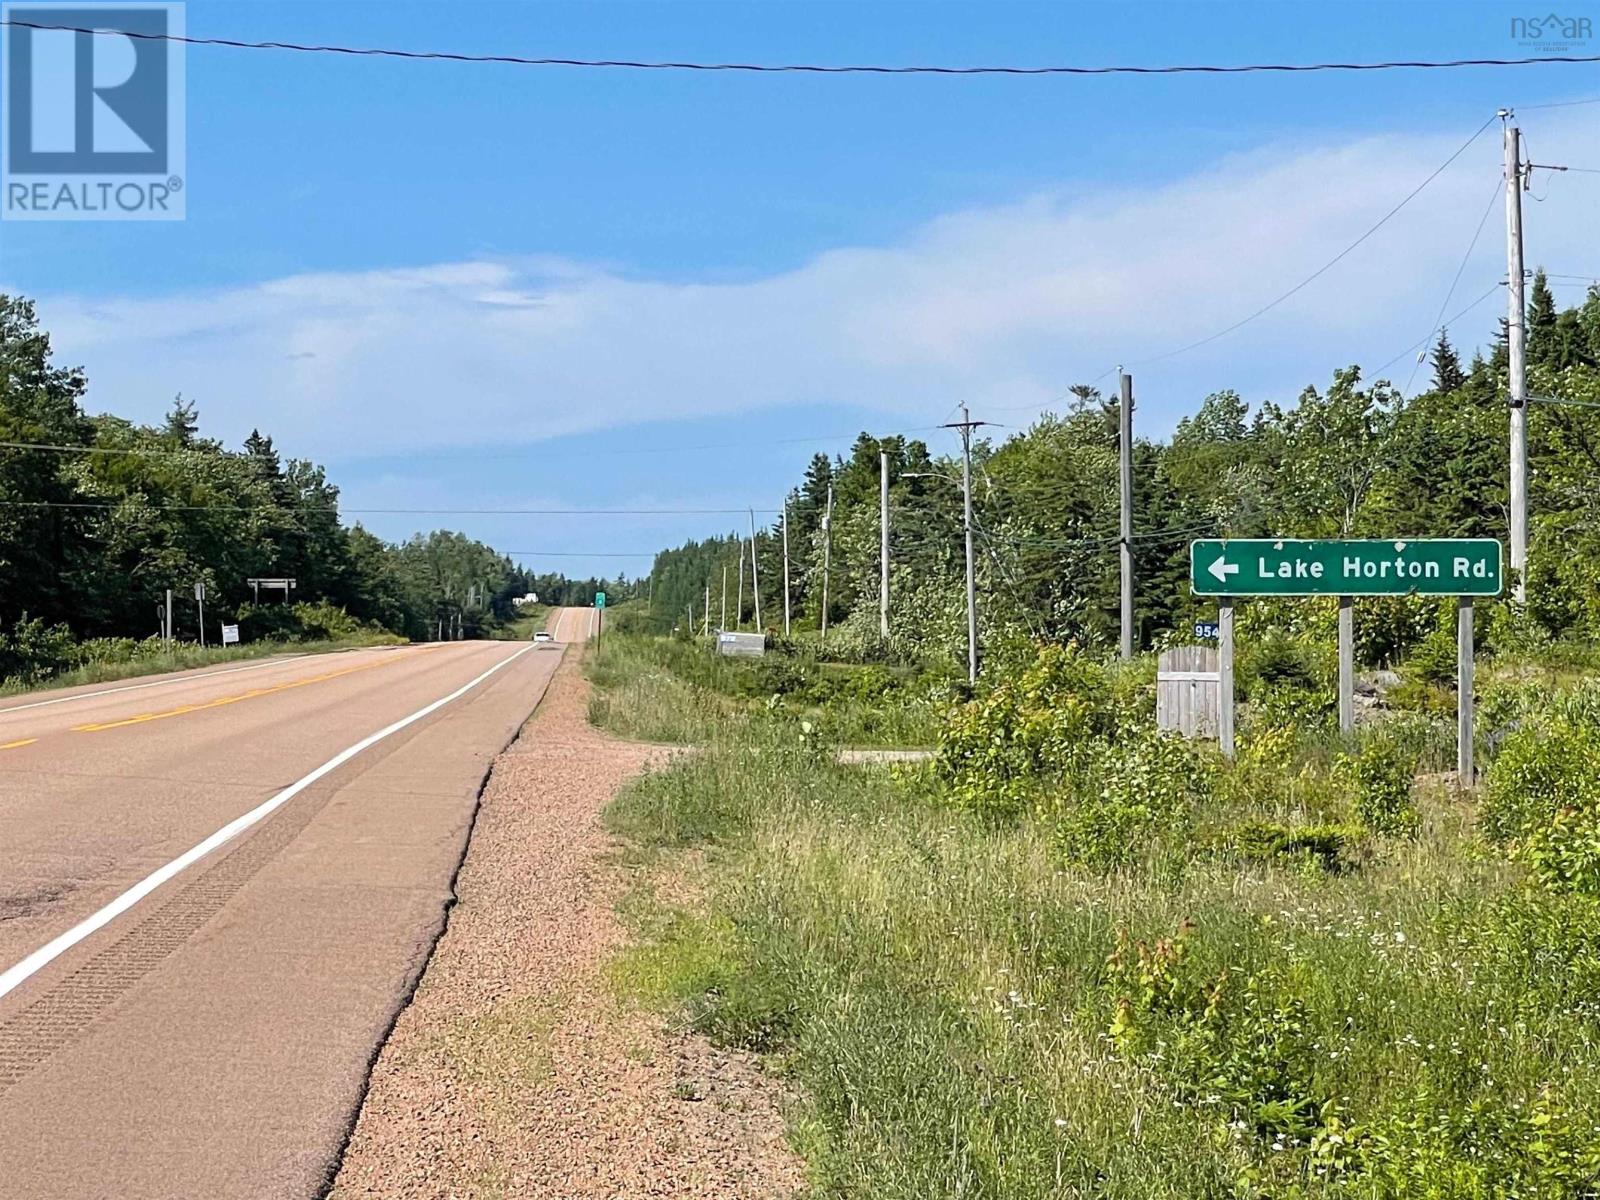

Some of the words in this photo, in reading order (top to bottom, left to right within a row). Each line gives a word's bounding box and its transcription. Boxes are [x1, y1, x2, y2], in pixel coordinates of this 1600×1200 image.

[1259, 557, 1324, 578] Lake
[1343, 557, 1439, 578] Horton
[1453, 557, 1494, 578] Rd.
[1195, 625, 1219, 638] 954
